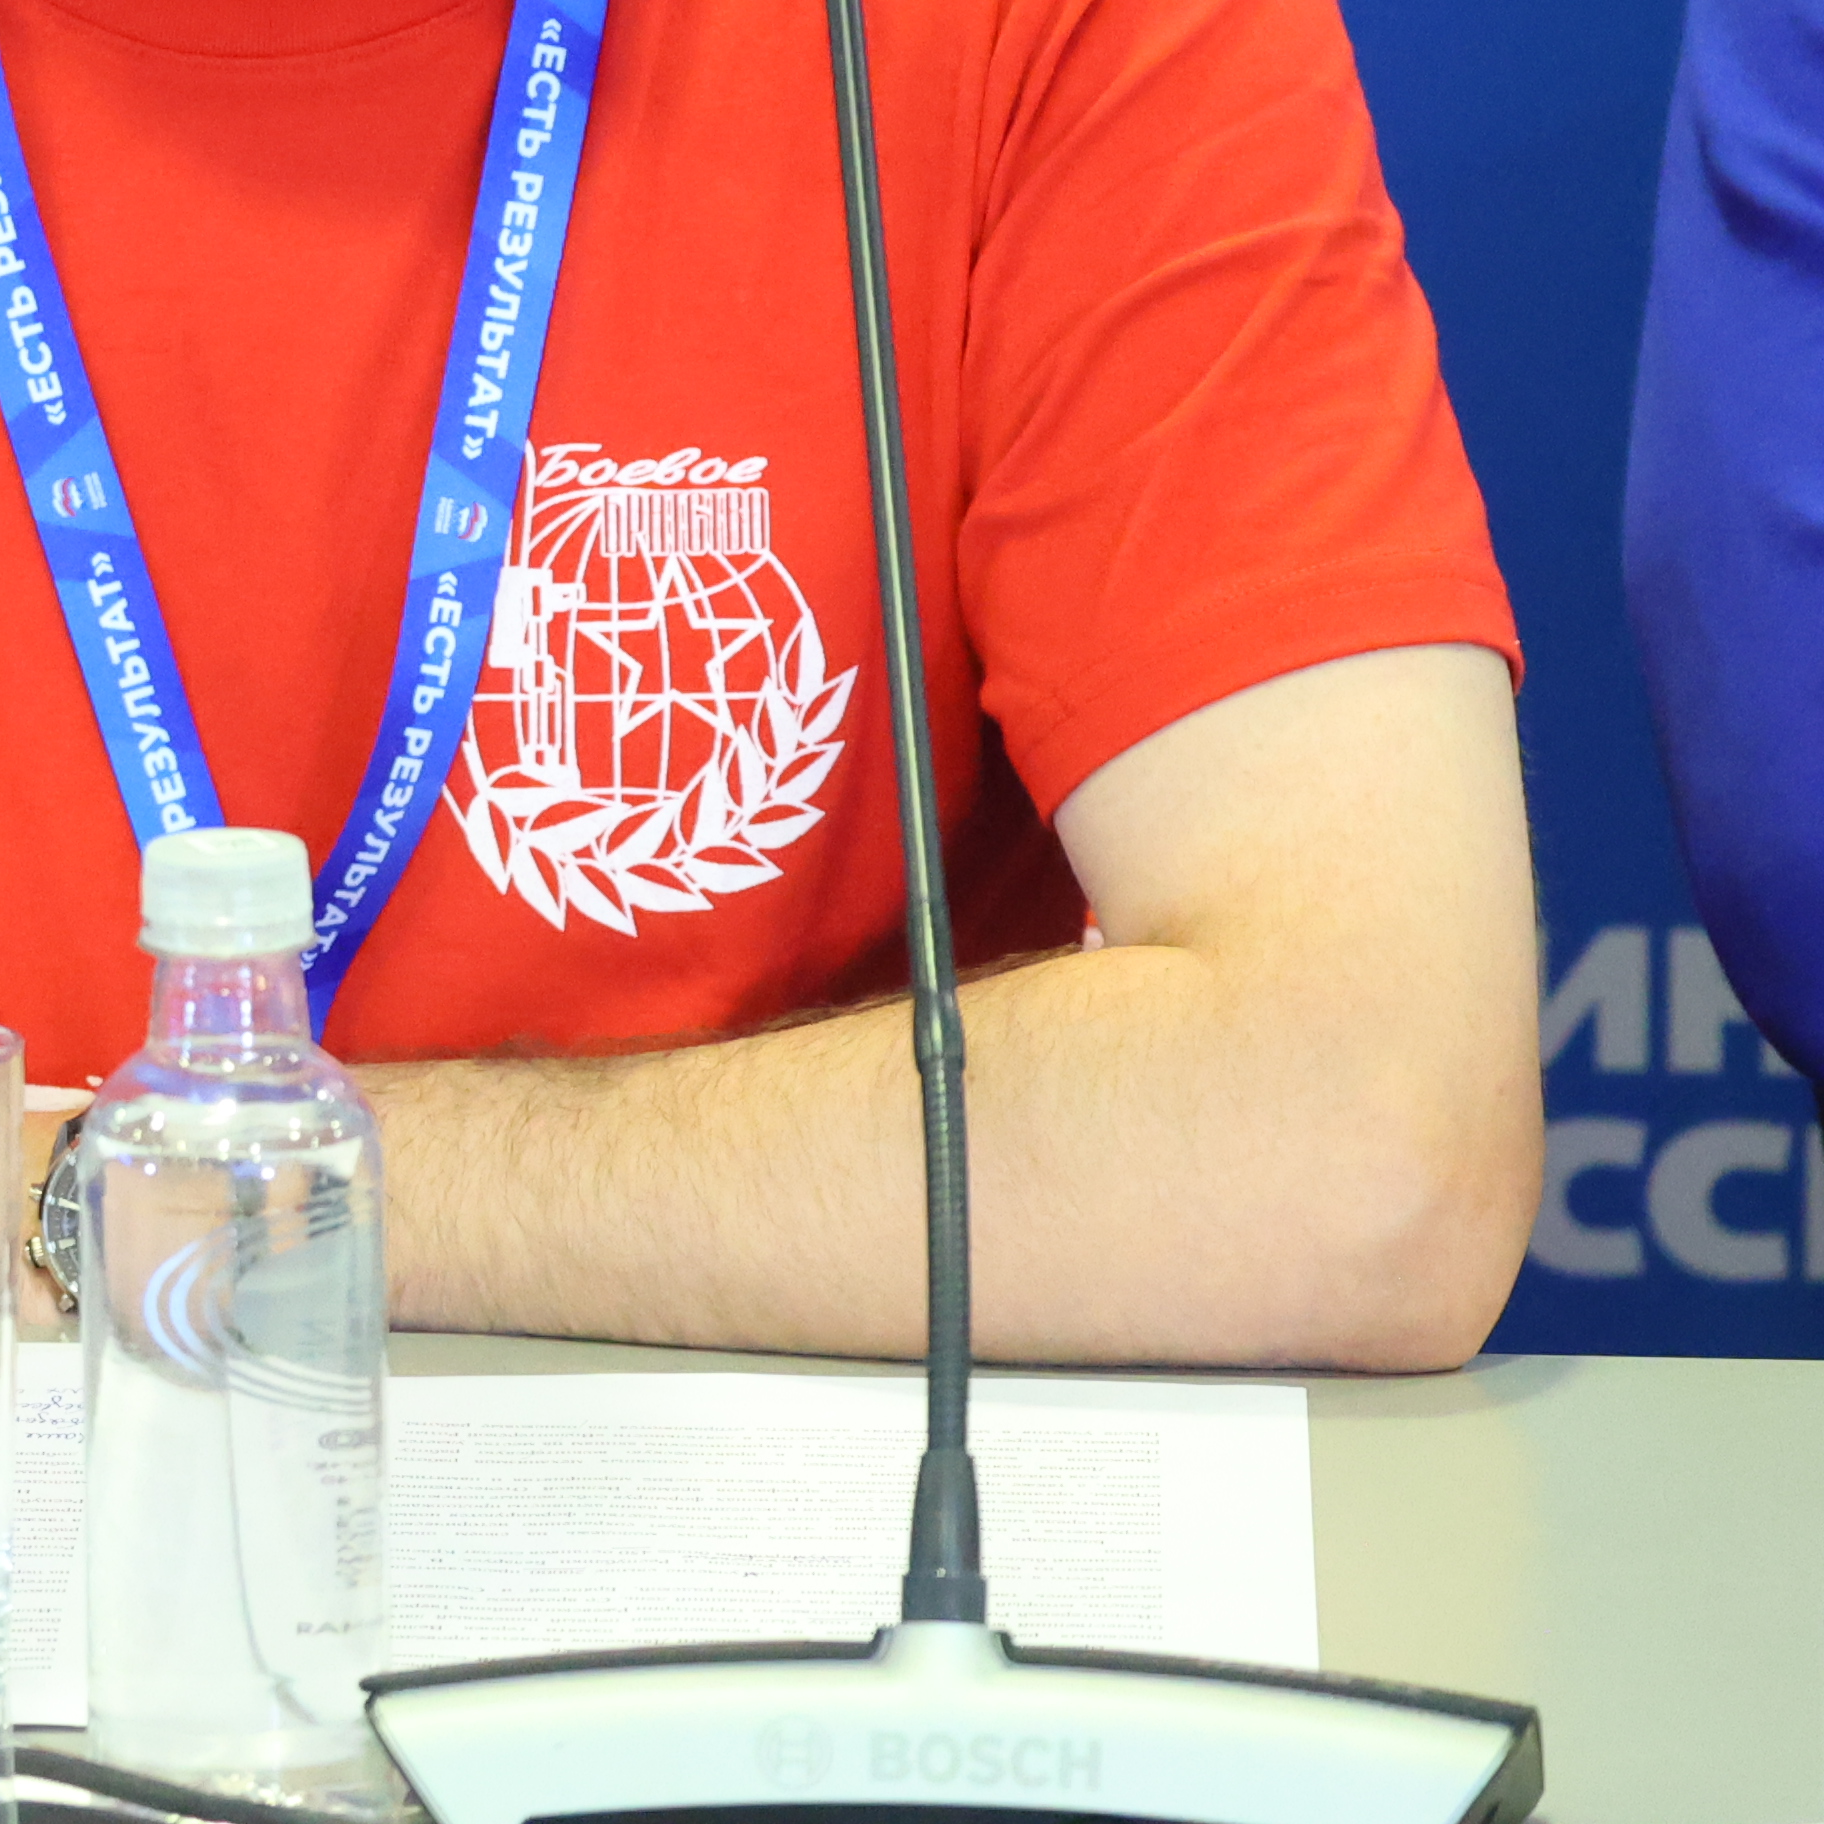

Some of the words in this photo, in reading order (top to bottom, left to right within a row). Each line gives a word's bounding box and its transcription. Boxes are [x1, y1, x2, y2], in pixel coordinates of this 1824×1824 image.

[517, 18, 567, 159] «ЕСТЬ
[4, 281, 67, 427] «ЕСТЬ
[461, 169, 544, 462] РЕЗУЛЬТАТ»
[535, 442, 769, 488] Боевое
[88, 551, 198, 832] РЕЗУЛЬТАТ»
[412, 571, 463, 715] «ЕСТЬ
[300, 726, 433, 971] РЕЗУЛЬТАТ»
[868, 1729, 1102, 1793] BOSCH
